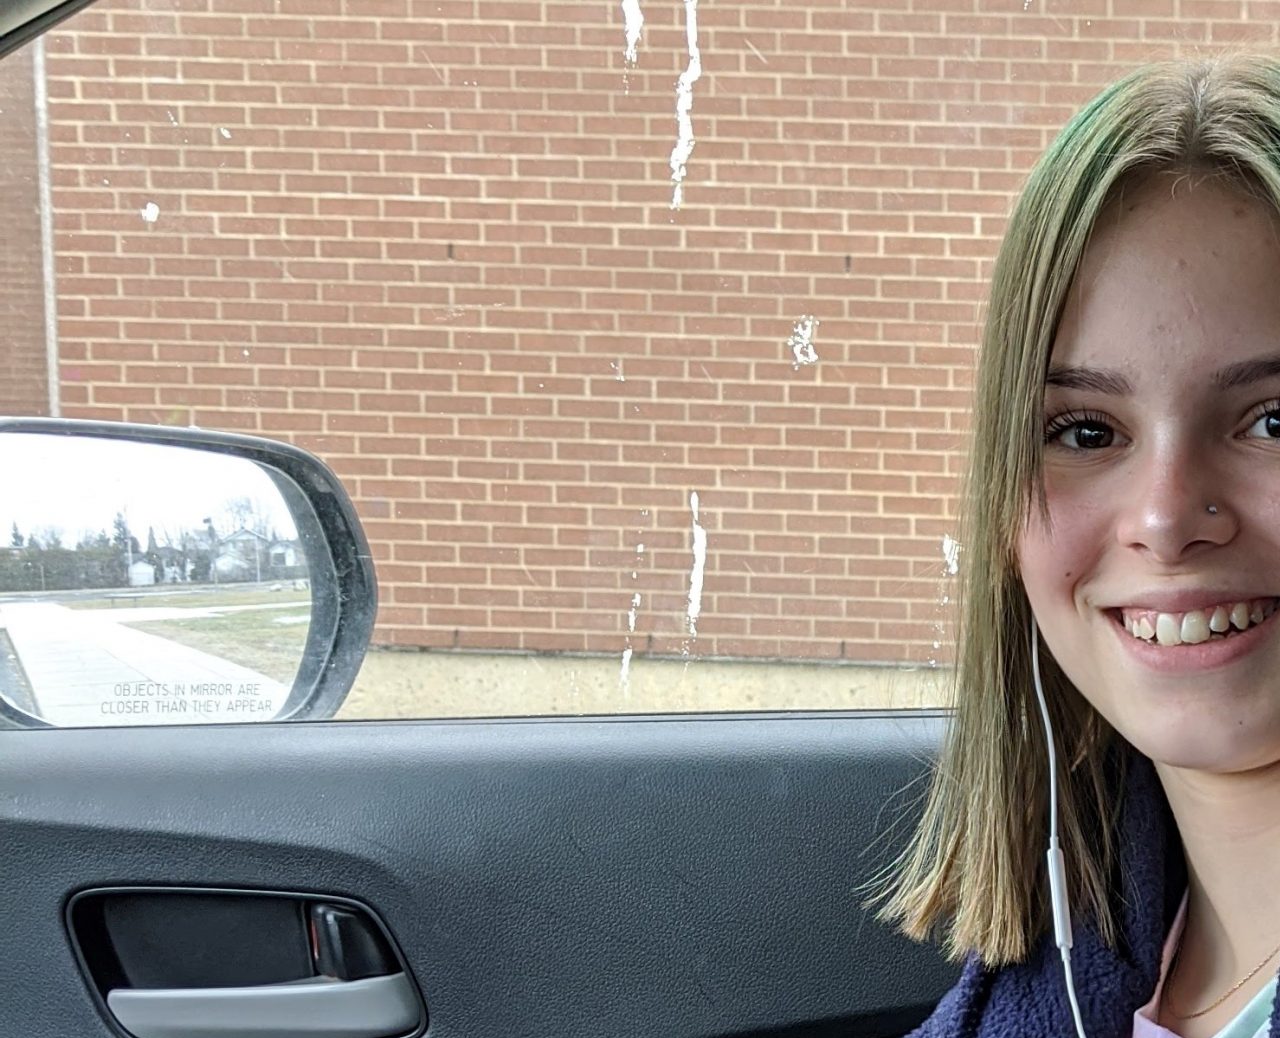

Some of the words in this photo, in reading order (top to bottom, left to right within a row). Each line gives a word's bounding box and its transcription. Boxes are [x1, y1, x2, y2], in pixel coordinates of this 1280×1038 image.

[114, 683, 169, 697] OBJECTS
[174, 683, 185, 696] IN
[190, 683, 233, 696] MIRROR
[237, 683, 261, 696] ARE
[101, 700, 149, 714] CLOSER
[155, 700, 187, 713] THAN
[193, 700, 222, 713] THEY
[226, 699, 272, 712] APPEAR
